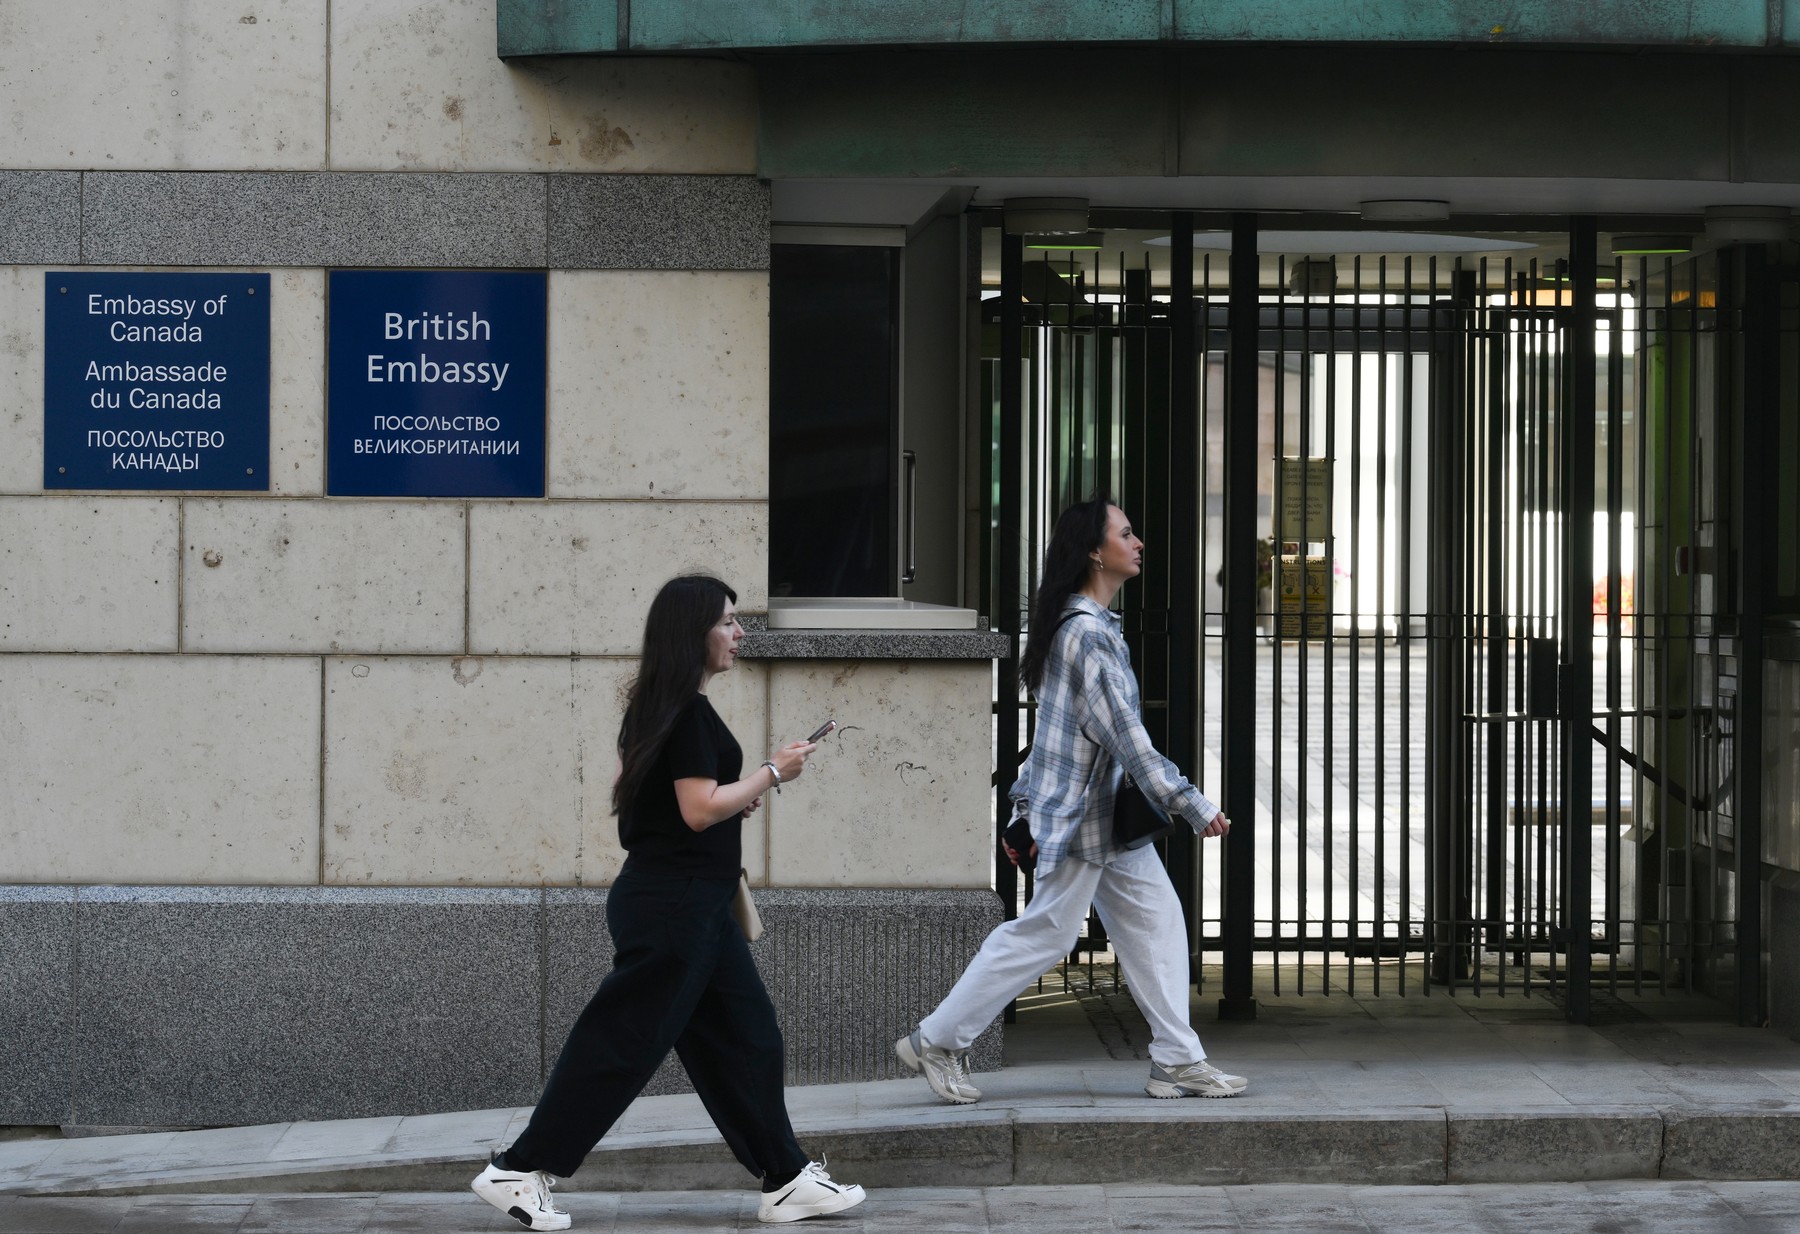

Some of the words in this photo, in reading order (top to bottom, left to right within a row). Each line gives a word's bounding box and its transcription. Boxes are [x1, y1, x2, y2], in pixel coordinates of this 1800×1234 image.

[88, 293, 197, 321] Embassy
[203, 294, 228, 316] of
[110, 320, 203, 343] Canada
[384, 311, 491, 341] British
[84, 360, 228, 383] Ambassade
[367, 353, 510, 392] Embassy
[90, 387, 121, 409] du
[129, 387, 222, 410] Canada
[374, 415, 501, 432] ПОСОЛЬСТВО
[87, 430, 225, 449] ПОСОЛЬСТВО
[354, 438, 520, 455] ВЕЛИКОБРИТАНИИ
[112, 452, 199, 473] КАНАДЫ
